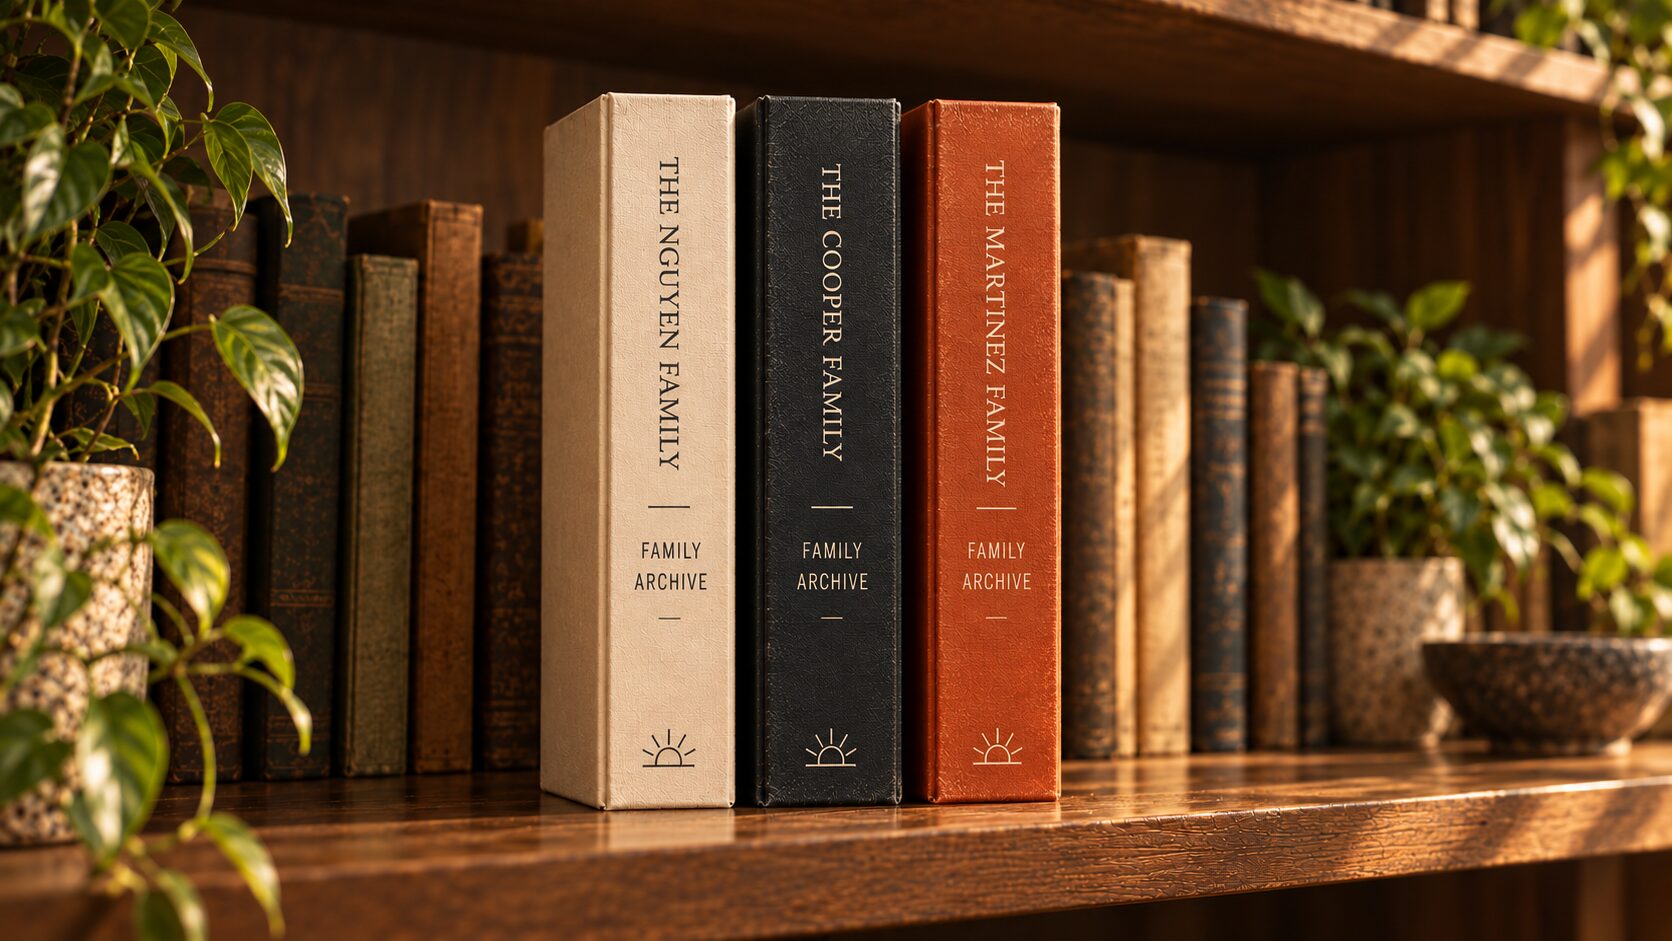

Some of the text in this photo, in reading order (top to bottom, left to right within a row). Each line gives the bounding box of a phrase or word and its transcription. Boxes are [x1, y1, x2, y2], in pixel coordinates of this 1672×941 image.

[658, 157, 681, 470] THE NGUYEN FAMILY
[821, 164, 843, 461] THE COOPER FAMILY
[985, 160, 1006, 487] THE MARTINEZ FAMILY
[641, 541, 701, 559] FAMILY
[802, 541, 863, 559] FAMILY
[968, 541, 1025, 559] FAMILY
[634, 572, 708, 590] ARCHIVE
[797, 572, 869, 590] ARCHIVE
[962, 572, 1032, 590] ARCHIVE
